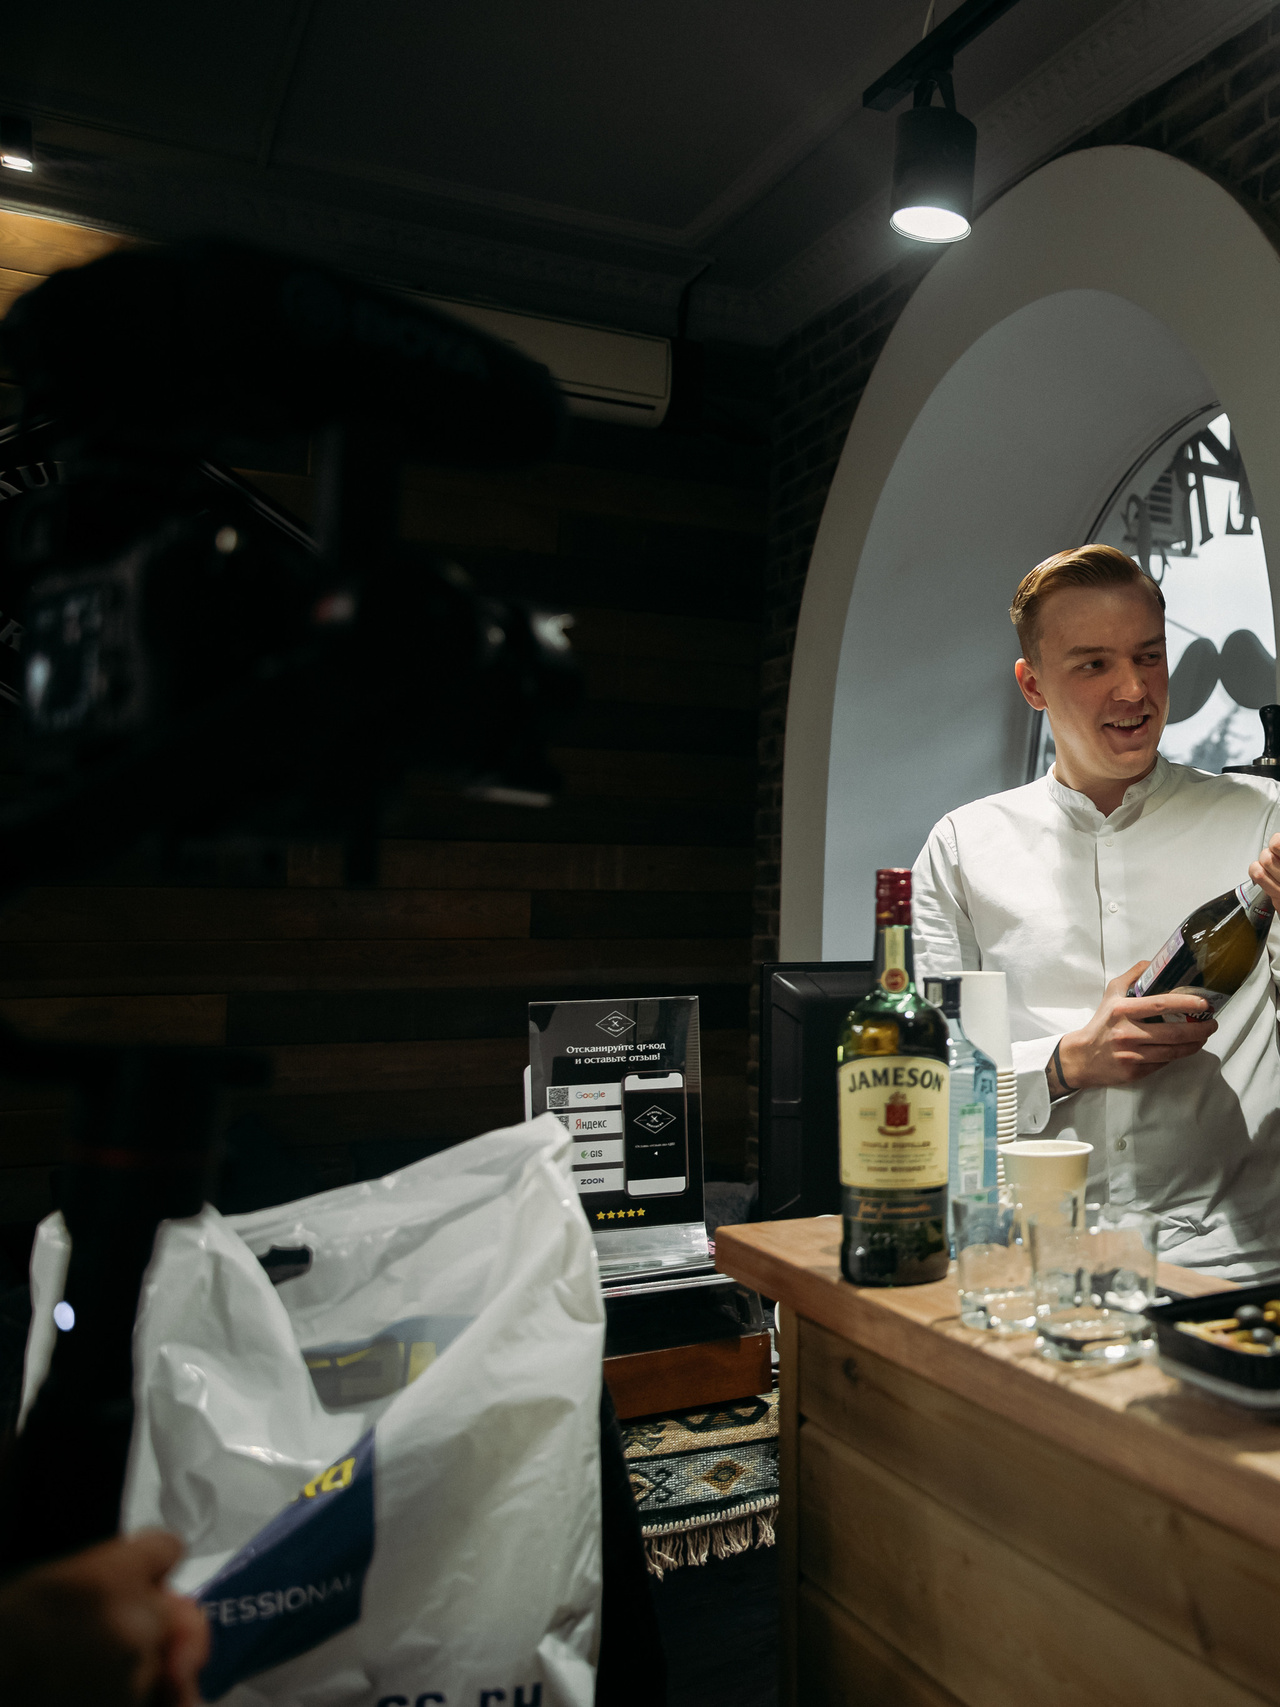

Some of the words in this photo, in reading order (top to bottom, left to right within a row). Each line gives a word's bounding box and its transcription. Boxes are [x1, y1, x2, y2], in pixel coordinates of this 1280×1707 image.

[565, 1043, 635, 1056] Отсканируйте
[636, 1041, 667, 1052] qr-код
[574, 1057, 582, 1065] и
[583, 1055, 628, 1065] оставьте
[628, 1053, 661, 1063] отзыв!
[848, 1067, 943, 1093] JAMESON
[575, 1090, 606, 1101] Google
[575, 1118, 608, 1130] Яндекс
[580, 1177, 605, 1186] ZOON
